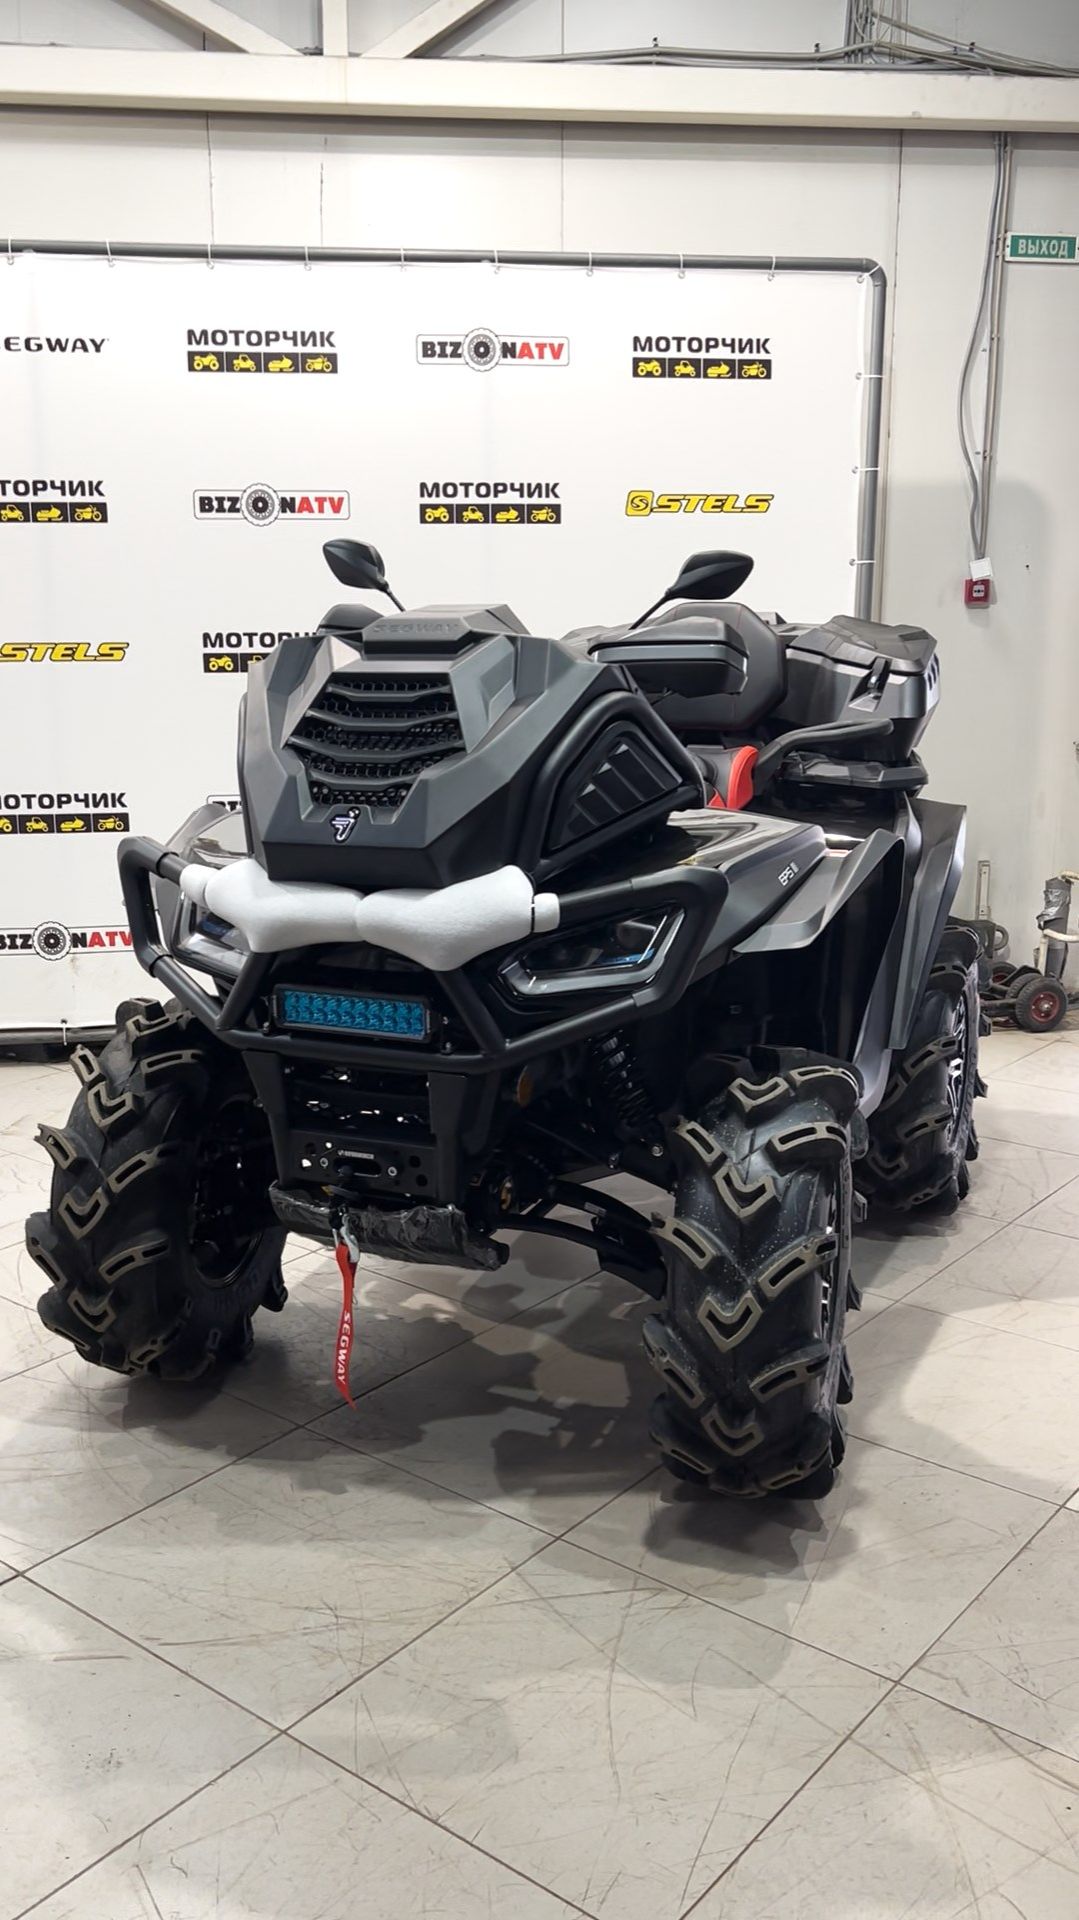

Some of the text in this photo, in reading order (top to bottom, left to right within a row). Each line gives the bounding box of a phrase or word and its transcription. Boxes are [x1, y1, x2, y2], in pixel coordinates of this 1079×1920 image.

[1018, 239, 1068, 258] ВЫХОД
[0, 336, 106, 353] EGWAY
[187, 328, 336, 348] МОТОРЧИК
[632, 335, 771, 354] МОТОРЧИК
[419, 481, 560, 499] МОТОРЧИК
[651, 494, 775, 513] STELS
[0, 642, 130, 662] STELS
[0, 792, 128, 810] ОТОРЧИК
[337, 1310, 351, 1385] SEGWAY
